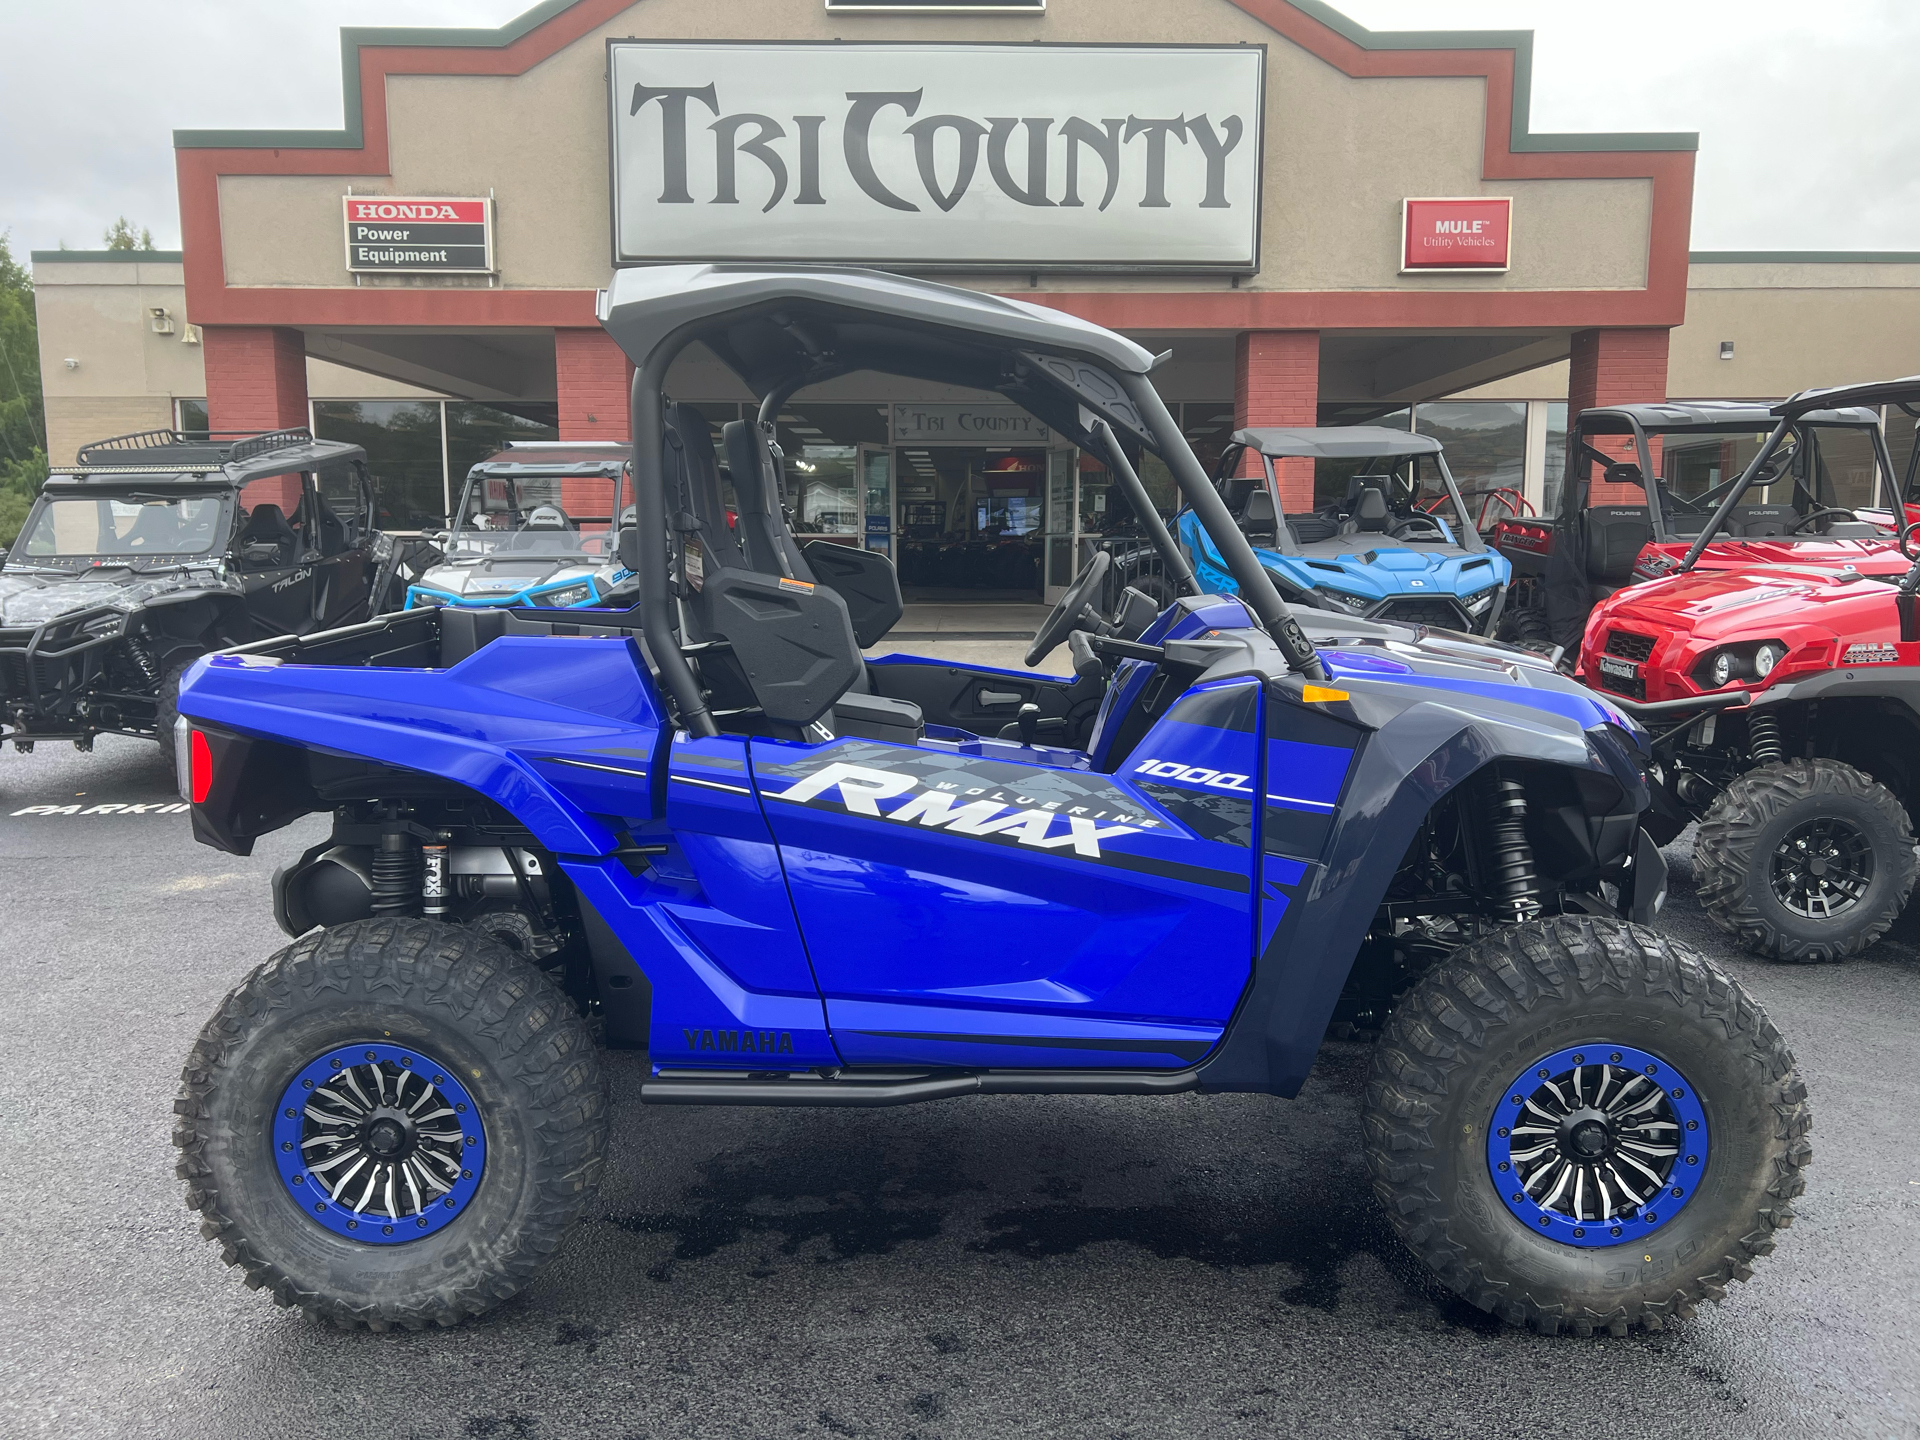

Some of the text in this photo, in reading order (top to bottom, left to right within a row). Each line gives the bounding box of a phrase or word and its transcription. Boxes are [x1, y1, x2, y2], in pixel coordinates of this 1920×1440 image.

[356, 204, 459, 219] HONDA
[357, 226, 410, 240] Power
[1423, 236, 1495, 249] Utility Vehicles
[358, 247, 447, 264] Equipment
[912, 412, 1032, 432] TRI COUNTY
[1018, 463, 1046, 472] HON
[1502, 534, 1537, 548] RANGER
[1639, 553, 1671, 570] XP
[271, 567, 313, 594] TALON
[611, 567, 637, 584] 90
[1600, 657, 1635, 679] Kawasaki
[1134, 759, 1252, 790] 1000
[935, 781, 1161, 828] WOLVERINE
[424, 857, 442, 895] FOX
[683, 1029, 794, 1054] YAMAHA
